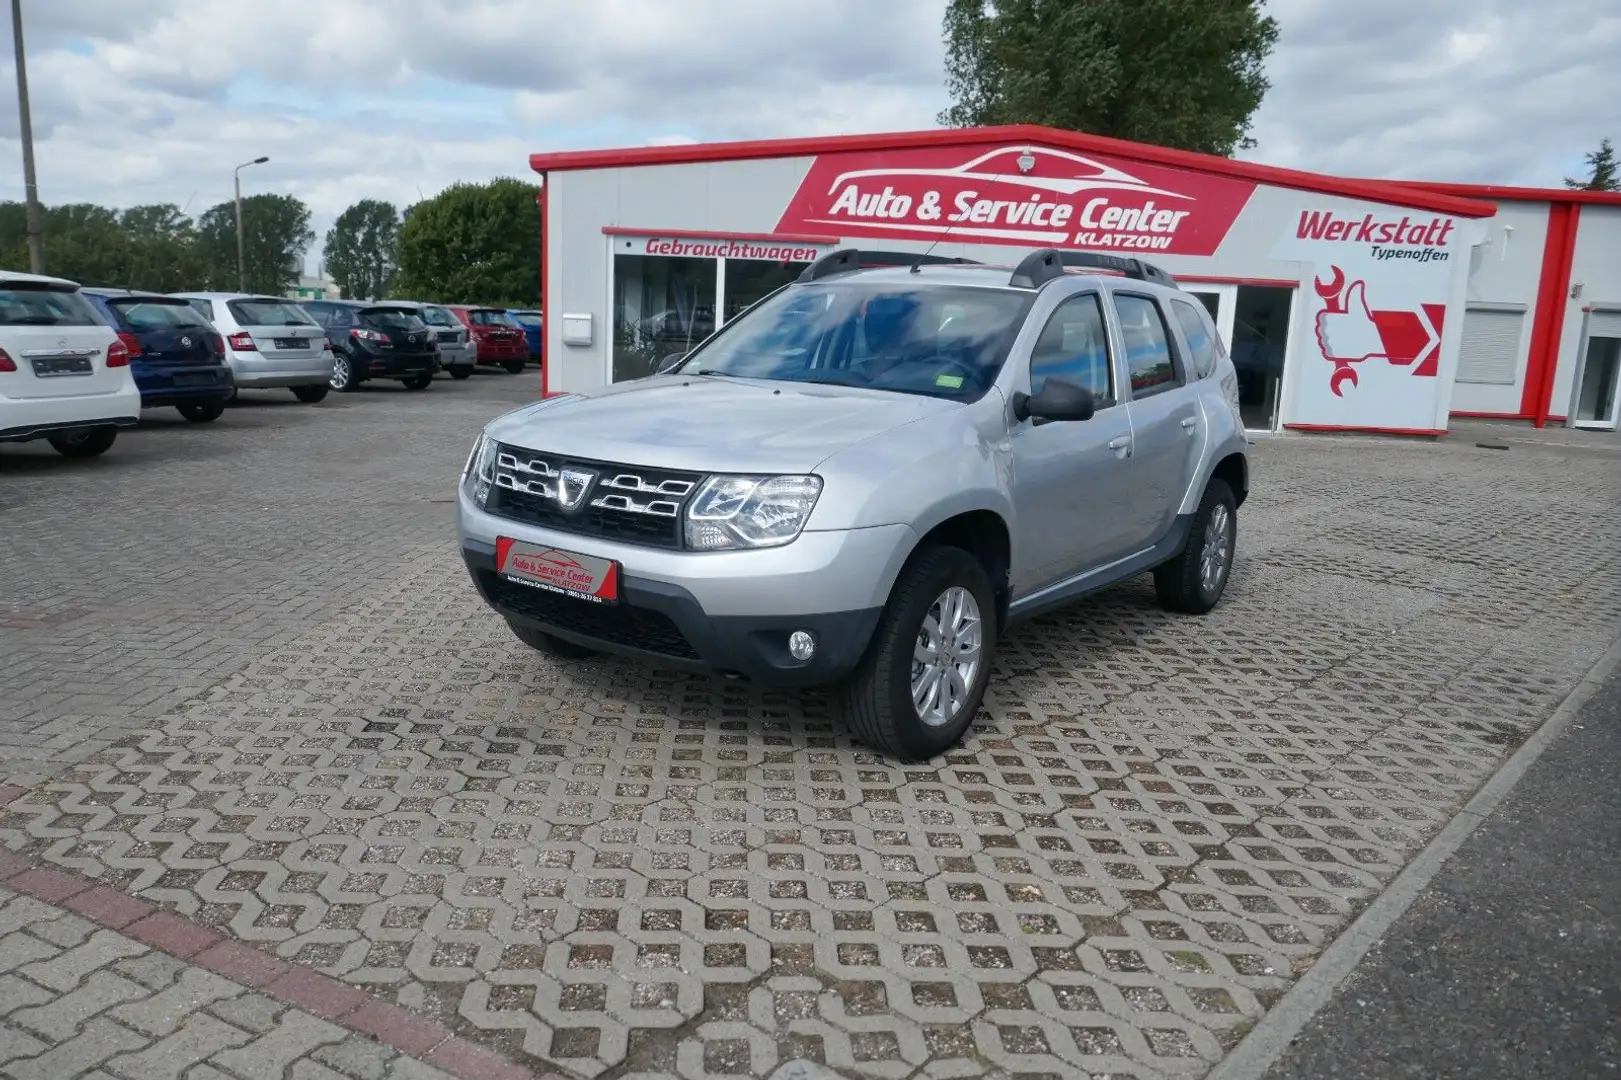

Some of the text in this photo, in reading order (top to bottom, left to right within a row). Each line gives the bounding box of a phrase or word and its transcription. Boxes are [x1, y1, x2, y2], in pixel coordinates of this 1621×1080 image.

[828, 184, 1190, 233] Auto & Service Center
[1073, 232, 1172, 249] KLATZOW
[1296, 210, 1454, 246] Werkstatt
[645, 238, 818, 264] Gebrauchtwagen
[1371, 246, 1449, 262] Typenoffen
[511, 557, 594, 583] Auto & Service Center
[552, 578, 592, 592] KLATZOW
